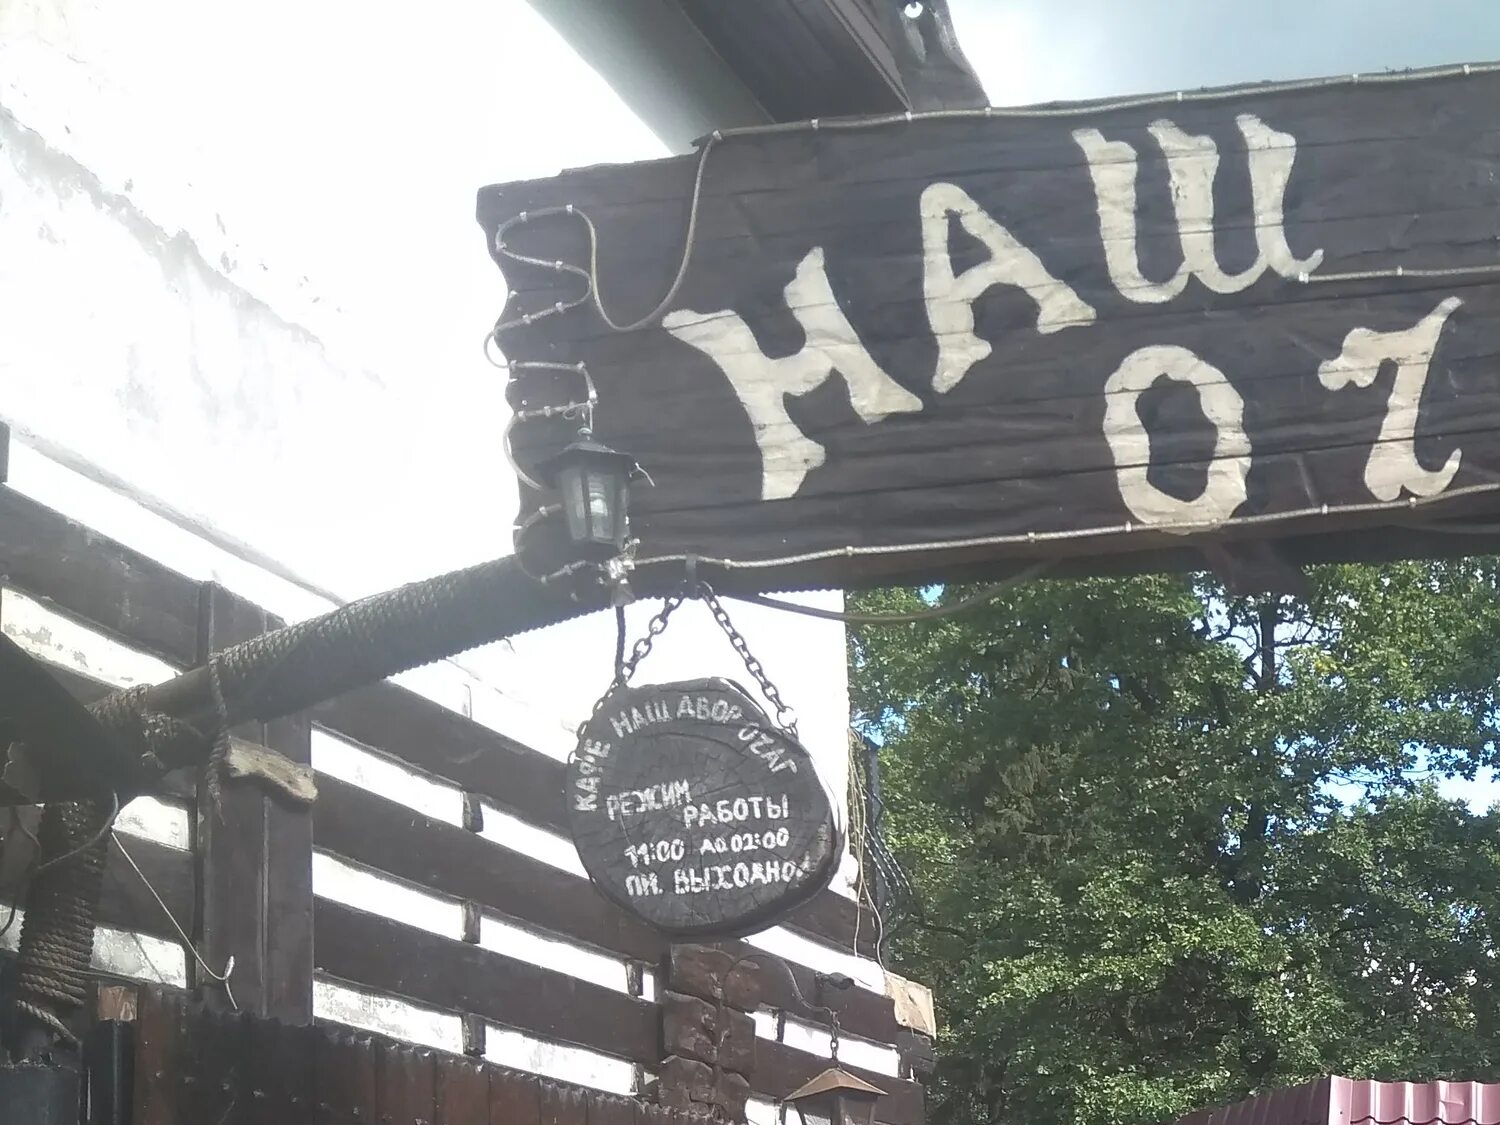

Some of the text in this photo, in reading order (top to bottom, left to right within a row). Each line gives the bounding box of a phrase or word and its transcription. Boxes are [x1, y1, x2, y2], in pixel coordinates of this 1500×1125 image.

[663, 111, 1323, 502] НАШ
[574, 738, 611, 812] КАФЕ
[609, 699, 672, 738] НАШ
[676, 695, 743, 723] ДВОР
[606, 778, 789, 828] РЕЖИМ РАБОТЫ
[730, 827, 790, 853] 02:00
